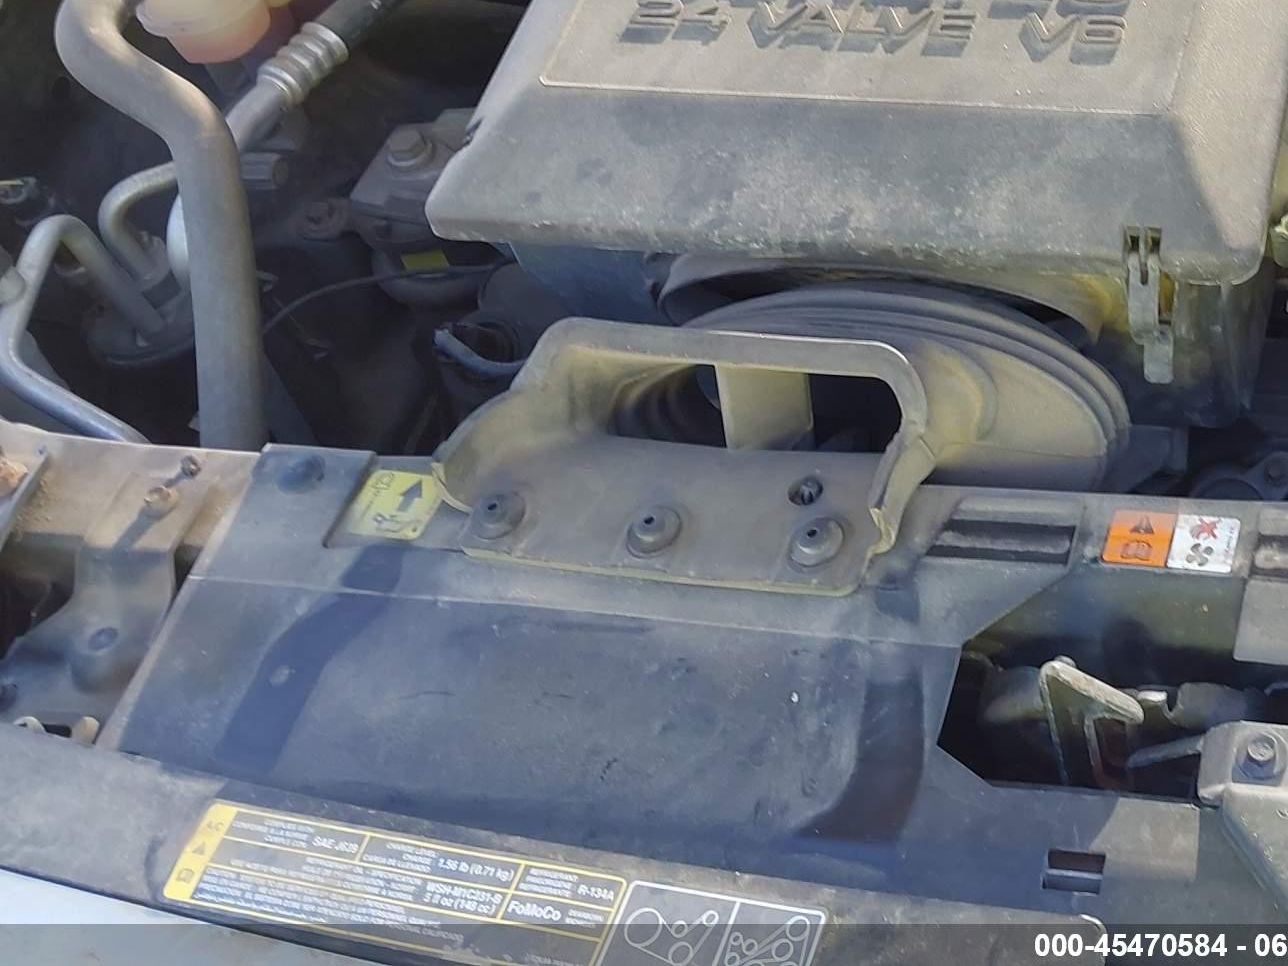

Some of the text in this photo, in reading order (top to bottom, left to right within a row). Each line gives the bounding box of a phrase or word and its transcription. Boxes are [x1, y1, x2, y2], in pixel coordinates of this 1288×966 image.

[754, 0, 976, 44] VALVE
[1023, 11, 1128, 48] V6
[507, 900, 561, 921] FoMoCo
